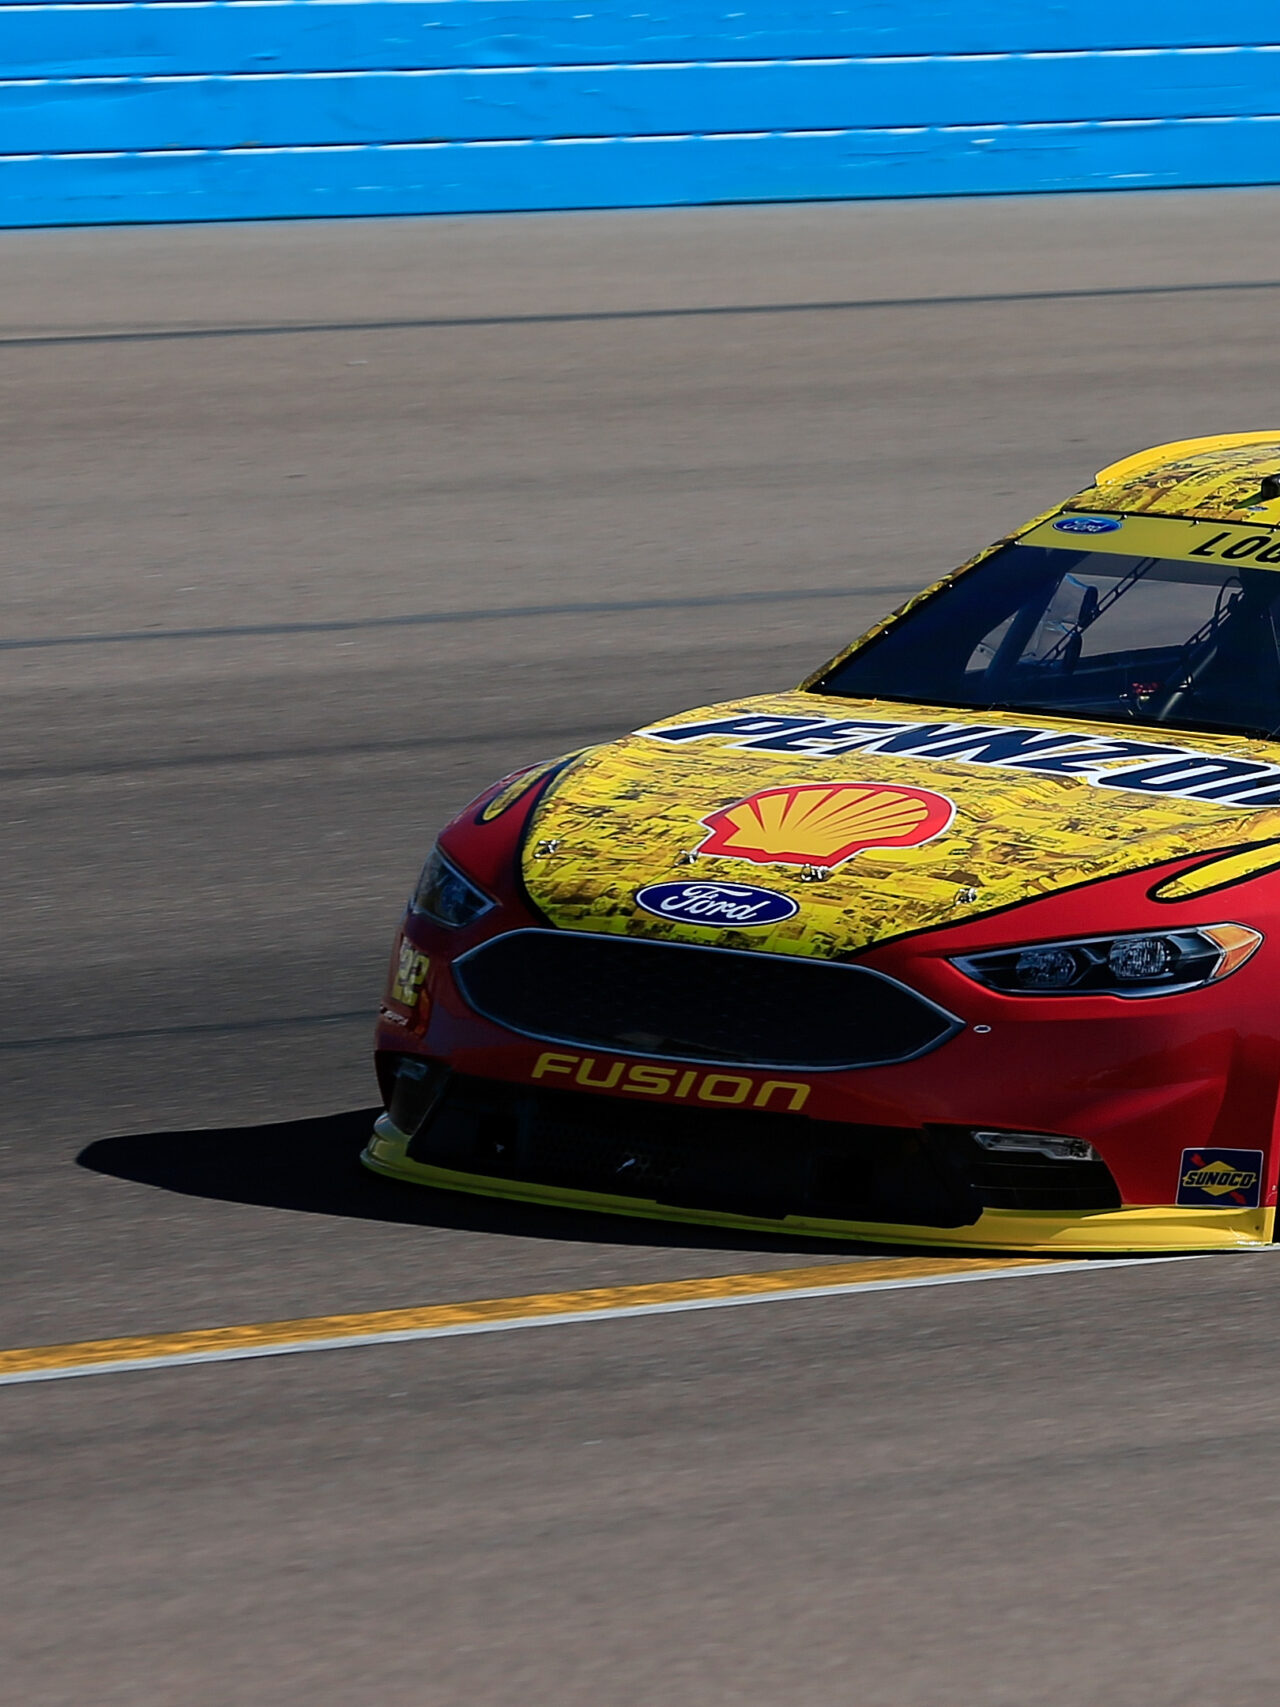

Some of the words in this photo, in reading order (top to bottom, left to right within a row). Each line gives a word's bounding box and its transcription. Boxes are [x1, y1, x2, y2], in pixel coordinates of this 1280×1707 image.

[660, 885, 771, 920] Ford
[531, 1052, 811, 1111] FUSION
[1186, 1171, 1255, 1188] SUNOCO
